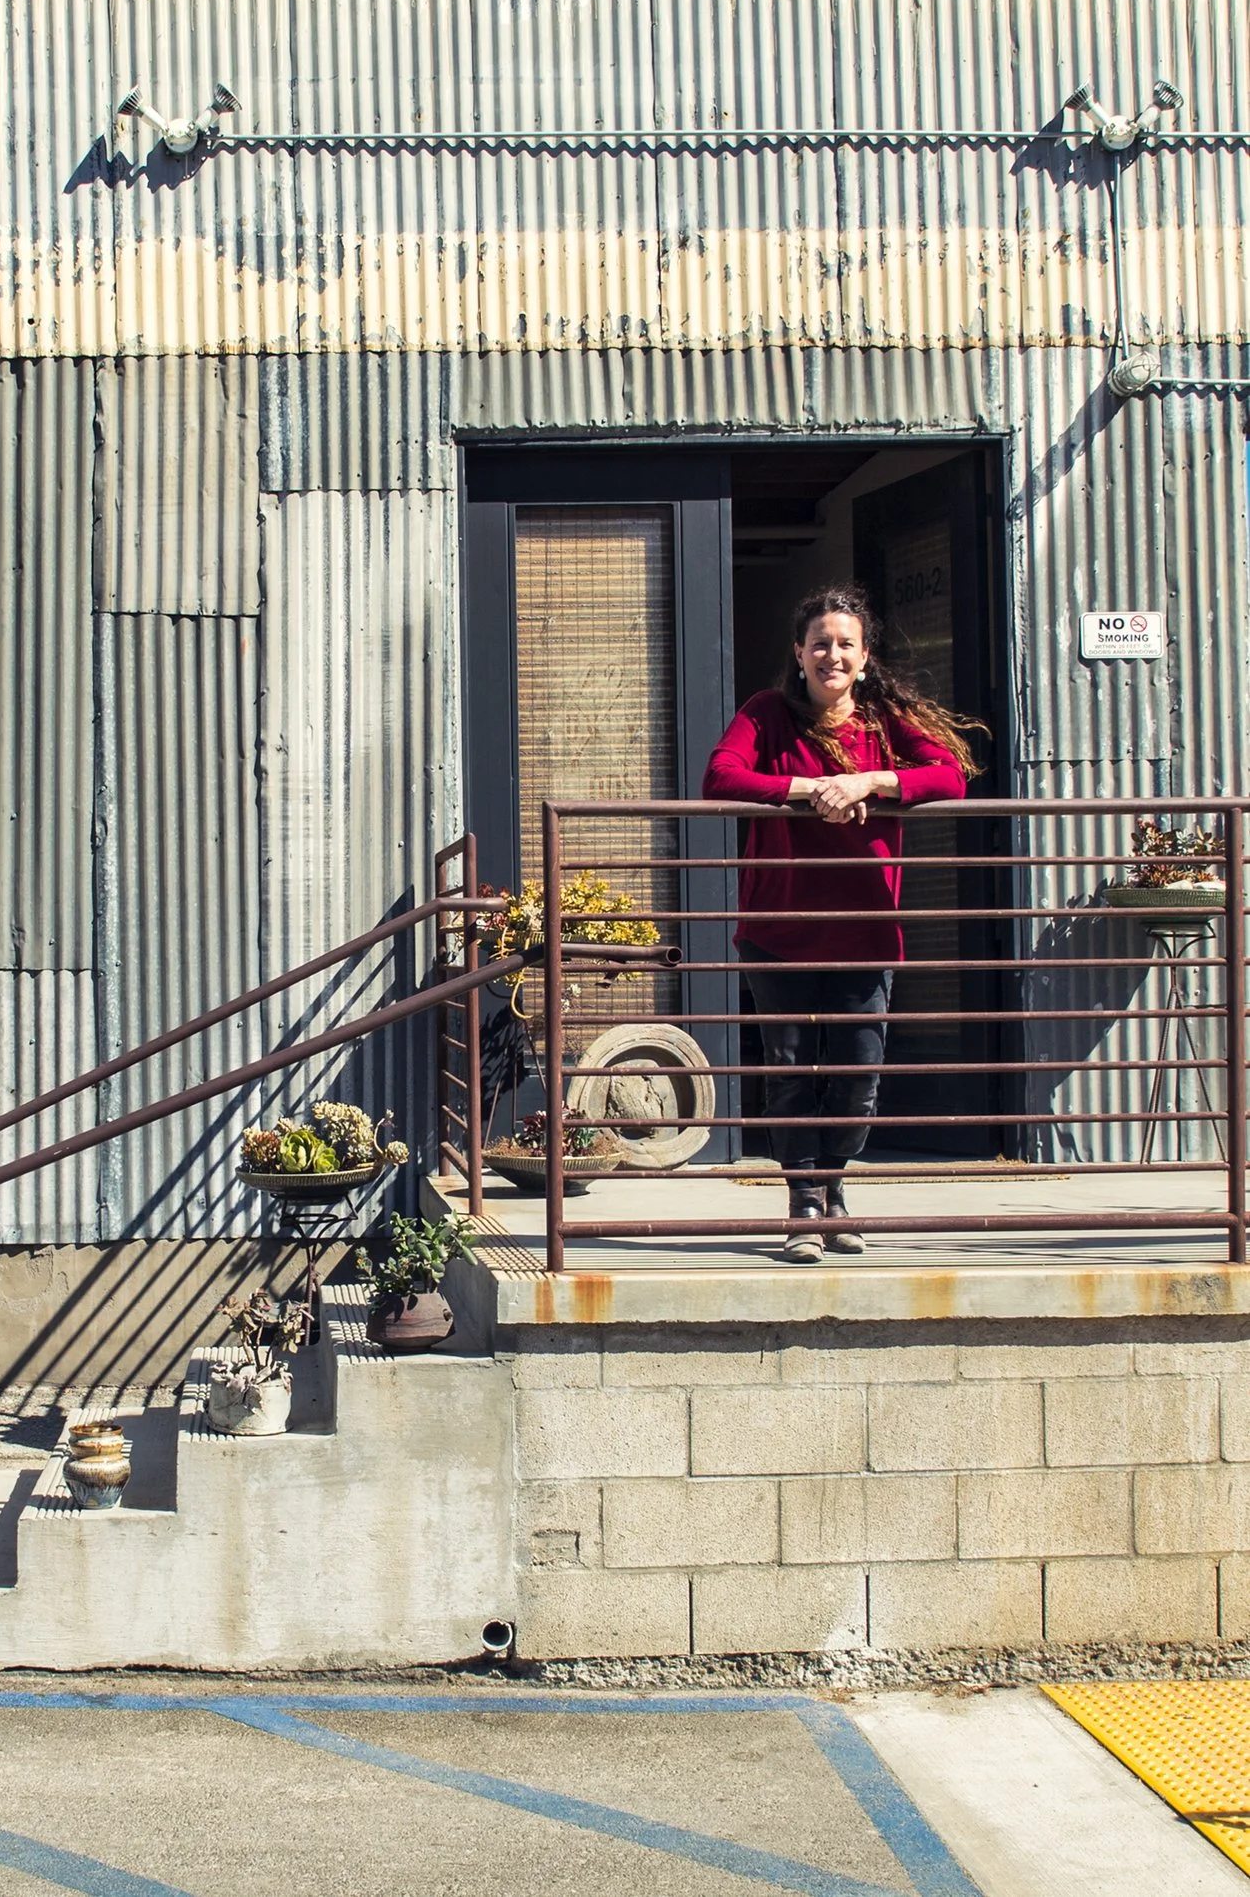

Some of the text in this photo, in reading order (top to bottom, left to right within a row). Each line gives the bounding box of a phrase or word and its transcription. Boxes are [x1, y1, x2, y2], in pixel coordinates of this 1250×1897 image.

[894, 566, 943, 605] 560-2
[1098, 618, 1125, 630] NO
[1097, 633, 1149, 643] SMOKING
